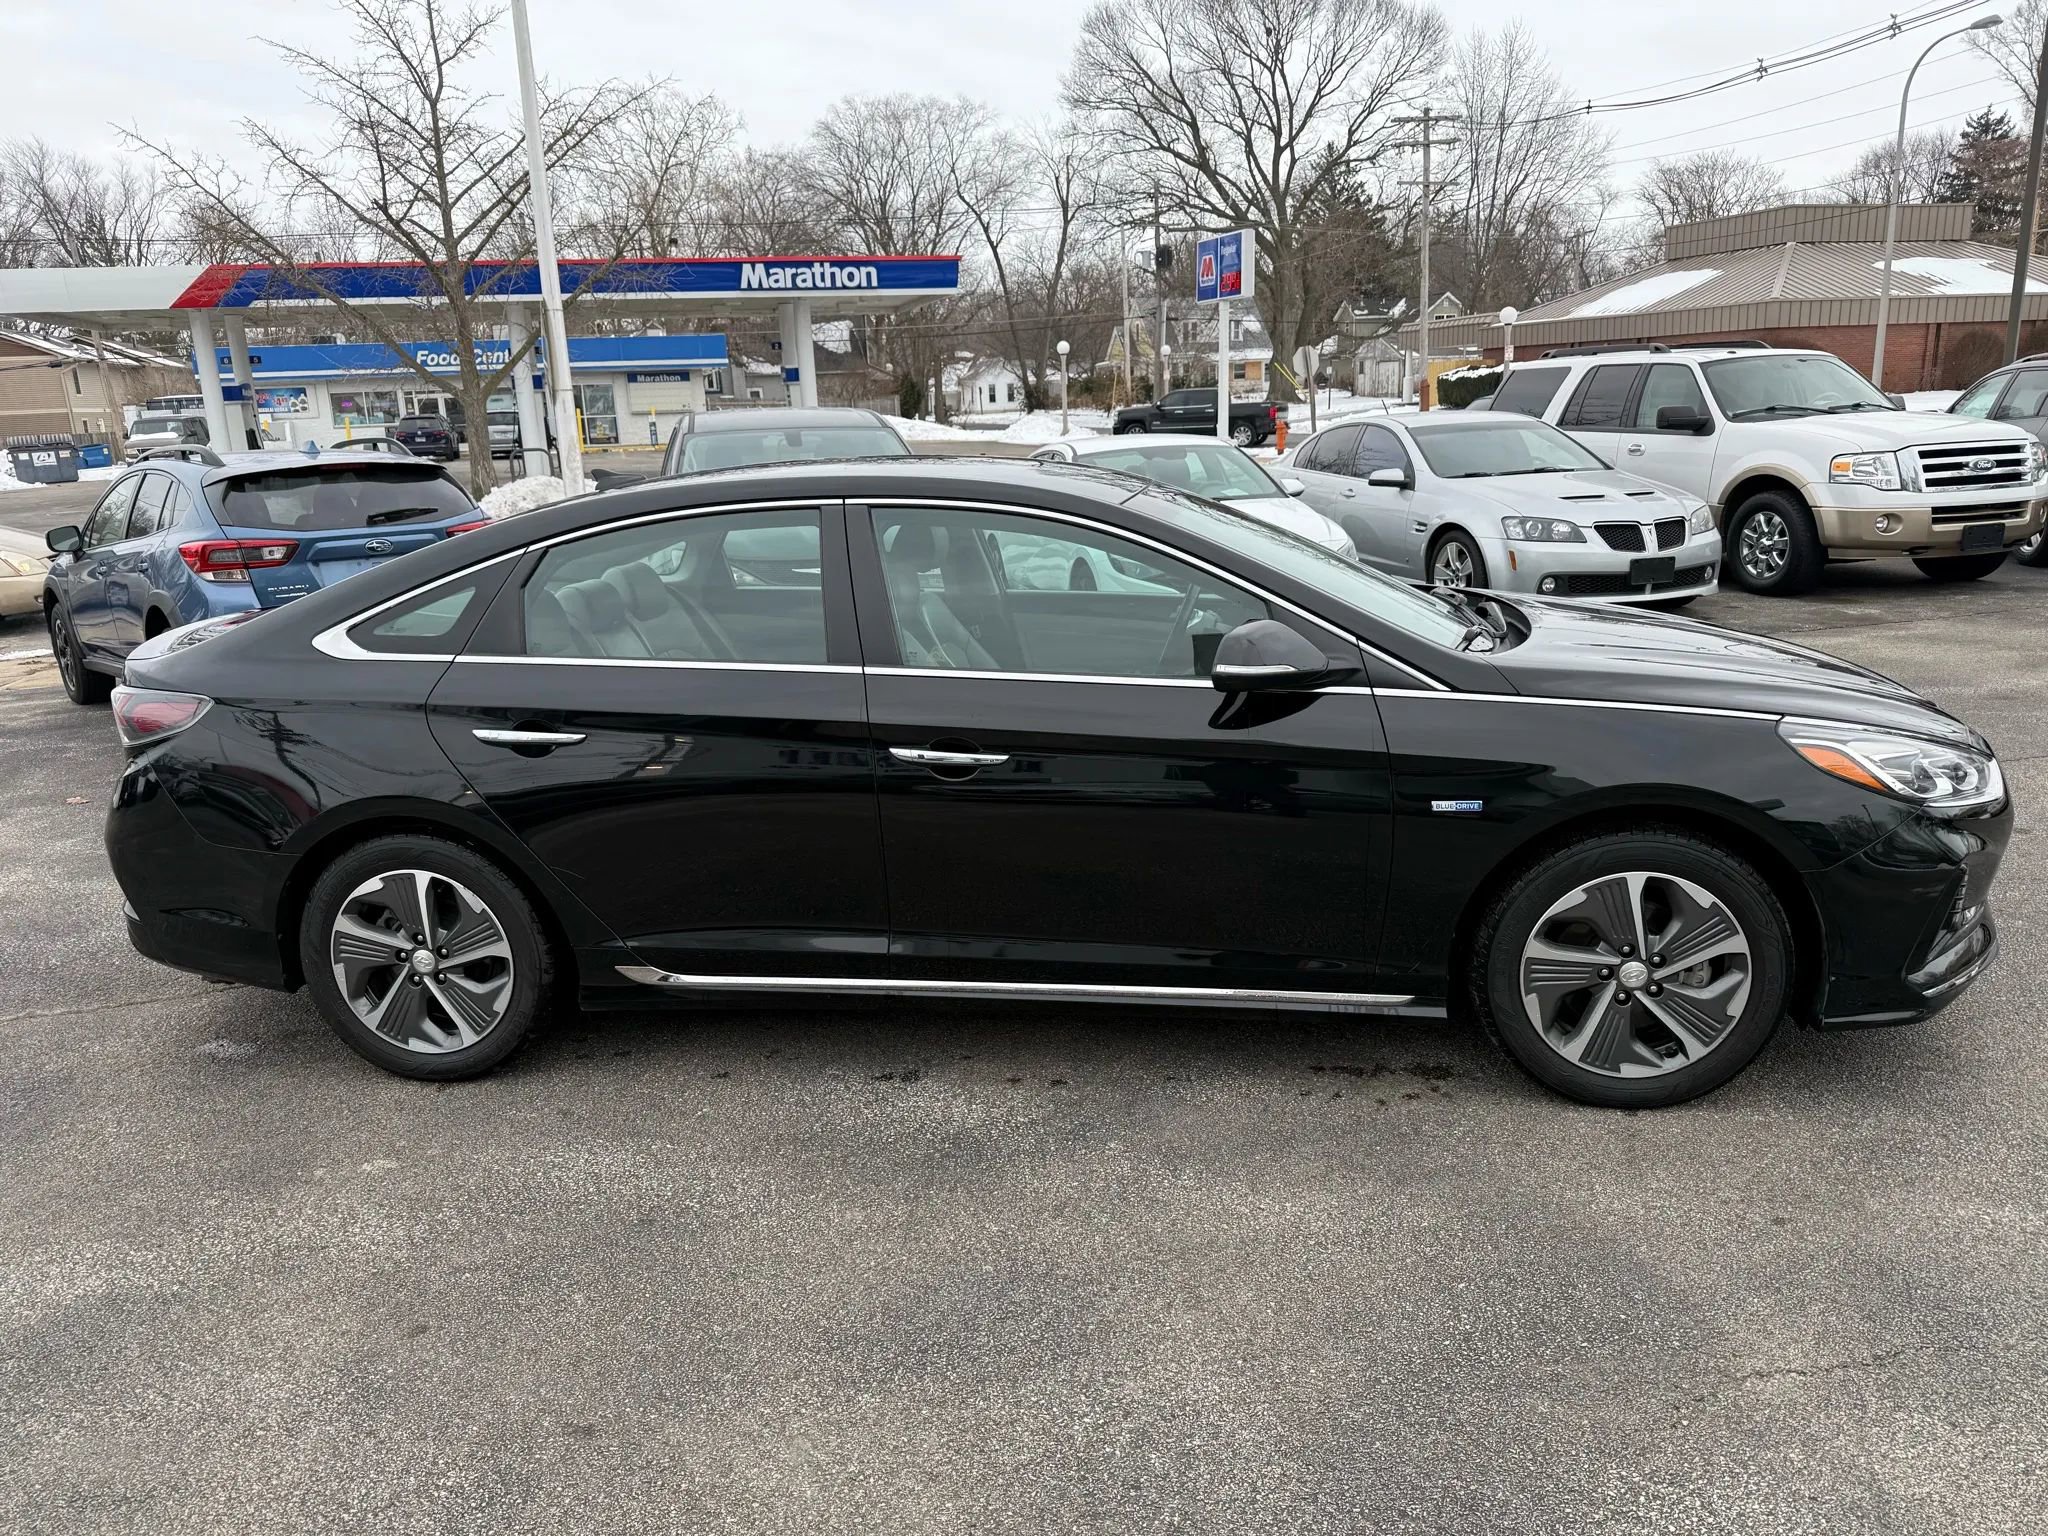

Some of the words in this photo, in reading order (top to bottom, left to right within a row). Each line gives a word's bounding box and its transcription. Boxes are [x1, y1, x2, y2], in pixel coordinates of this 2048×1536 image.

[740, 262, 878, 289] Marathon
[636, 374, 681, 382] Marathon
[1977, 460, 1992, 469] Ford
